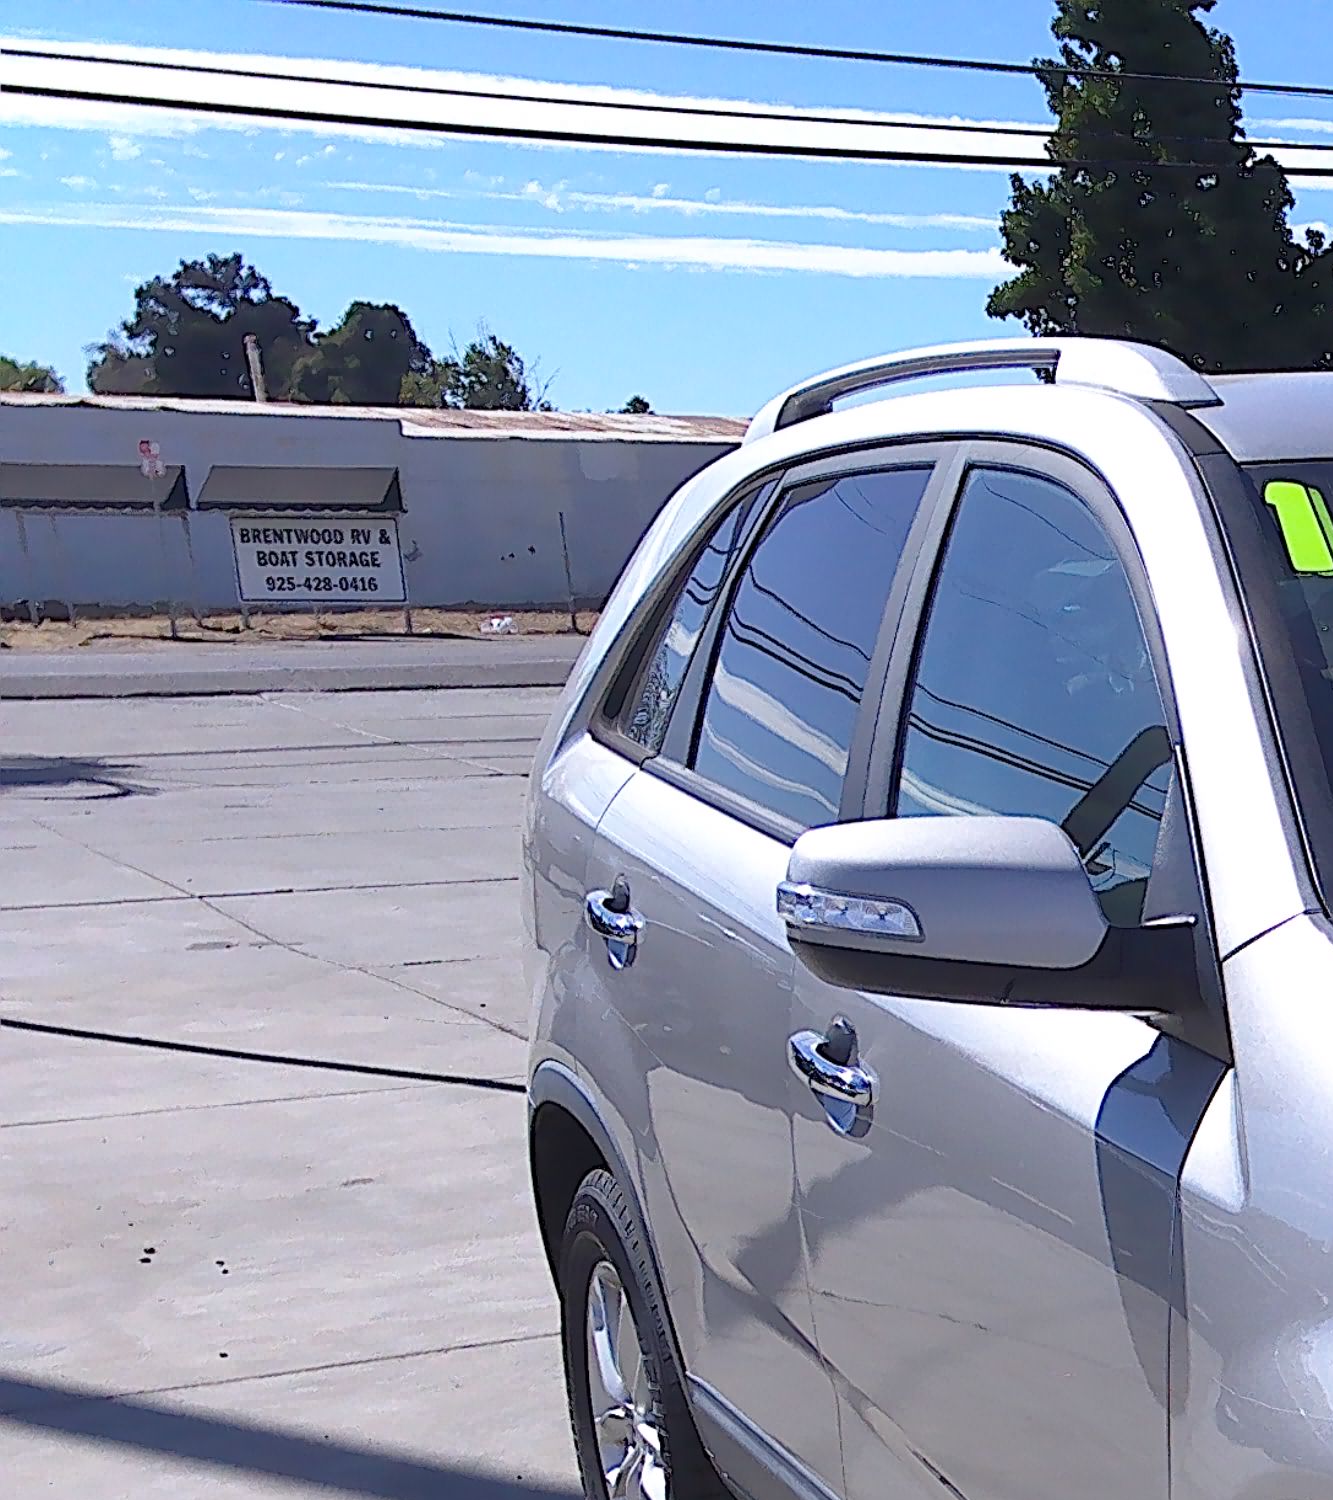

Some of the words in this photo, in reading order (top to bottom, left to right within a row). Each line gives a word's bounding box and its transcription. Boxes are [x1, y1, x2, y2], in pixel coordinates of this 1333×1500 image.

[239, 528, 344, 544] BRENTWOOD
[351, 528, 372, 544] RV
[379, 528, 391, 544] &
[256, 551, 299, 567] BOAT
[305, 551, 381, 567] STORAGE
[266, 576, 378, 592] 925-428-0416
